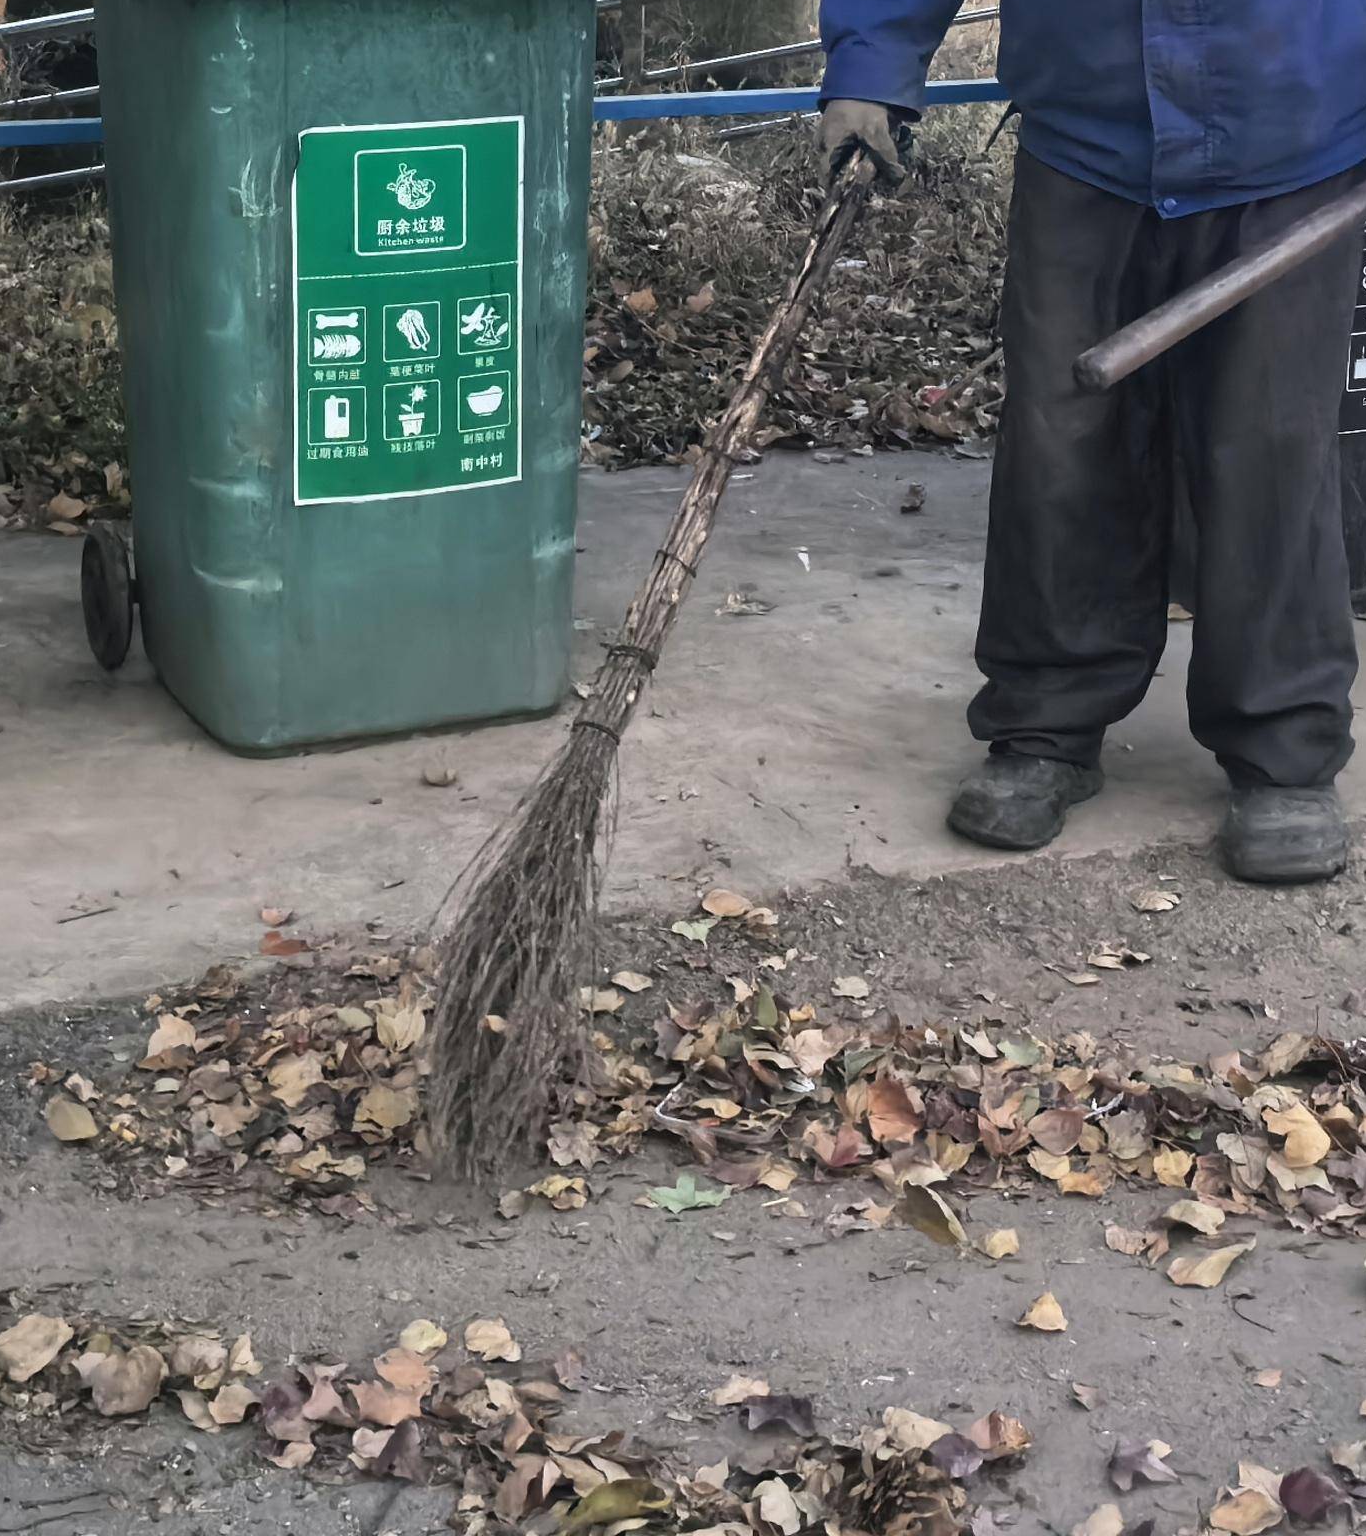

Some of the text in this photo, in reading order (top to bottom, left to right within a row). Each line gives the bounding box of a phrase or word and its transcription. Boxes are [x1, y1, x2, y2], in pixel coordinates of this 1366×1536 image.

[376, 216, 445, 236] 厨余垃圾
[377, 236, 414, 247] Kitchen
[460, 452, 503, 472] 南中村
